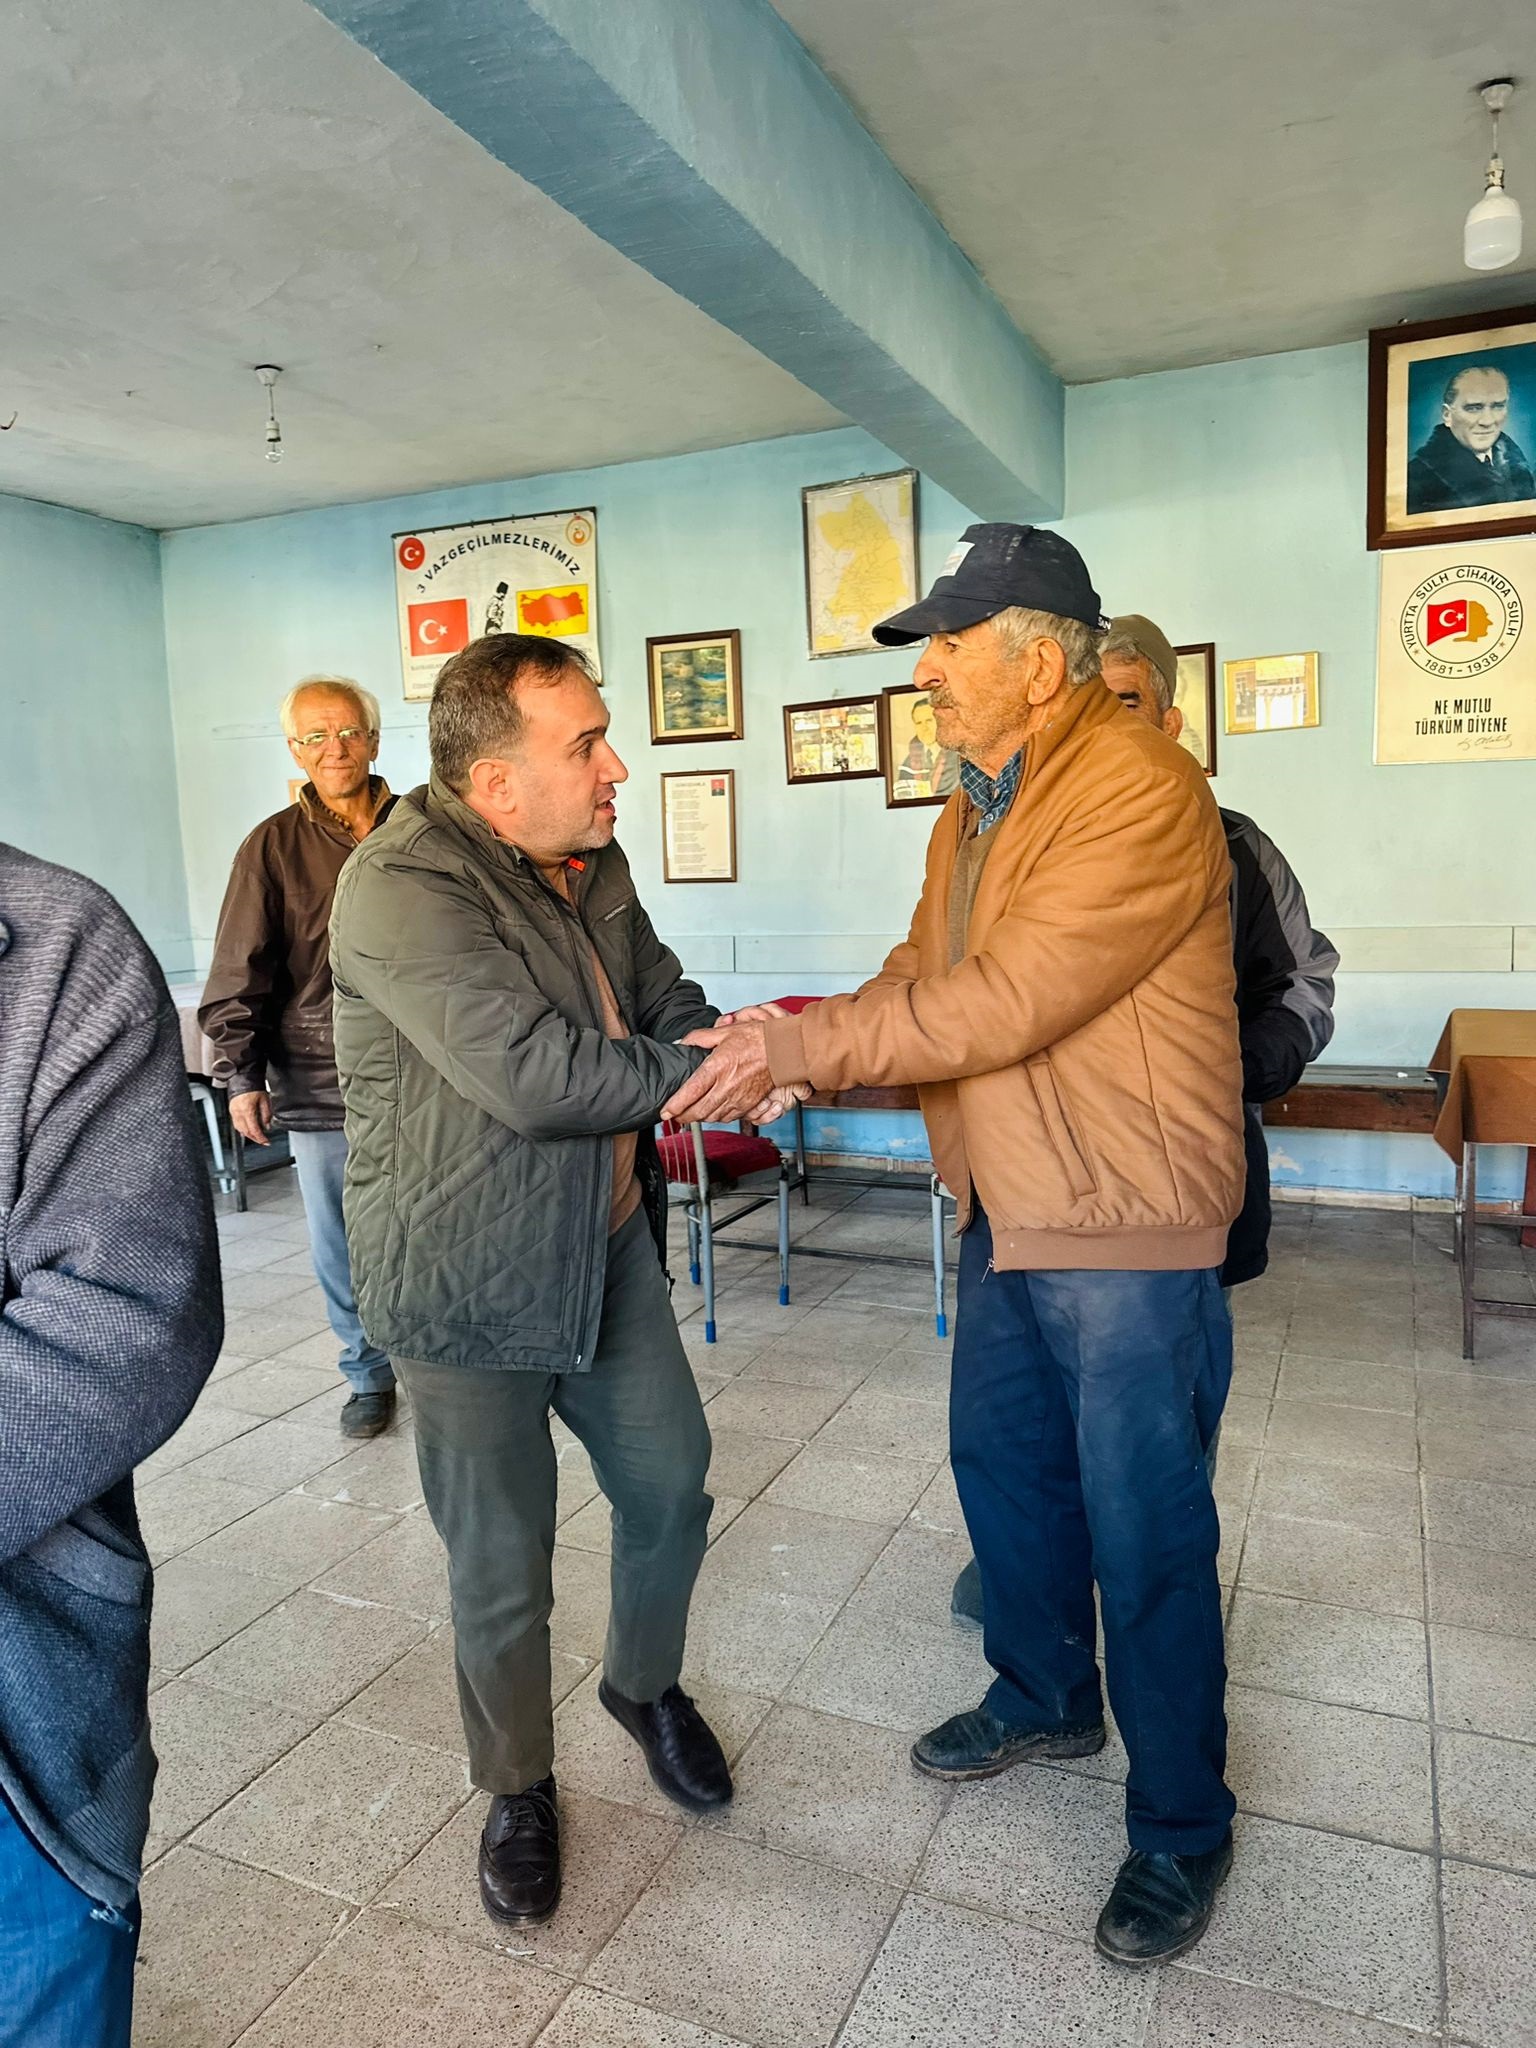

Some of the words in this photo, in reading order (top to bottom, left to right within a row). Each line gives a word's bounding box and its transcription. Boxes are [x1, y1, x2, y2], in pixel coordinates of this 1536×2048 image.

[416, 584, 426, 594] 3
[425, 533, 581, 581] VAZGEÇİLMEZLERİMİZ
[1404, 604, 1419, 649] YURTTA
[1416, 573, 1450, 600] SULH
[1456, 566, 1511, 598] CİHANDA
[1506, 600, 1519, 637] SULH
[1415, 717, 1463, 735] TÜRKÜM
[1467, 715, 1508, 733] DİYENE
[1434, 700, 1448, 715] NE
[1453, 698, 1492, 714] MUTLU
